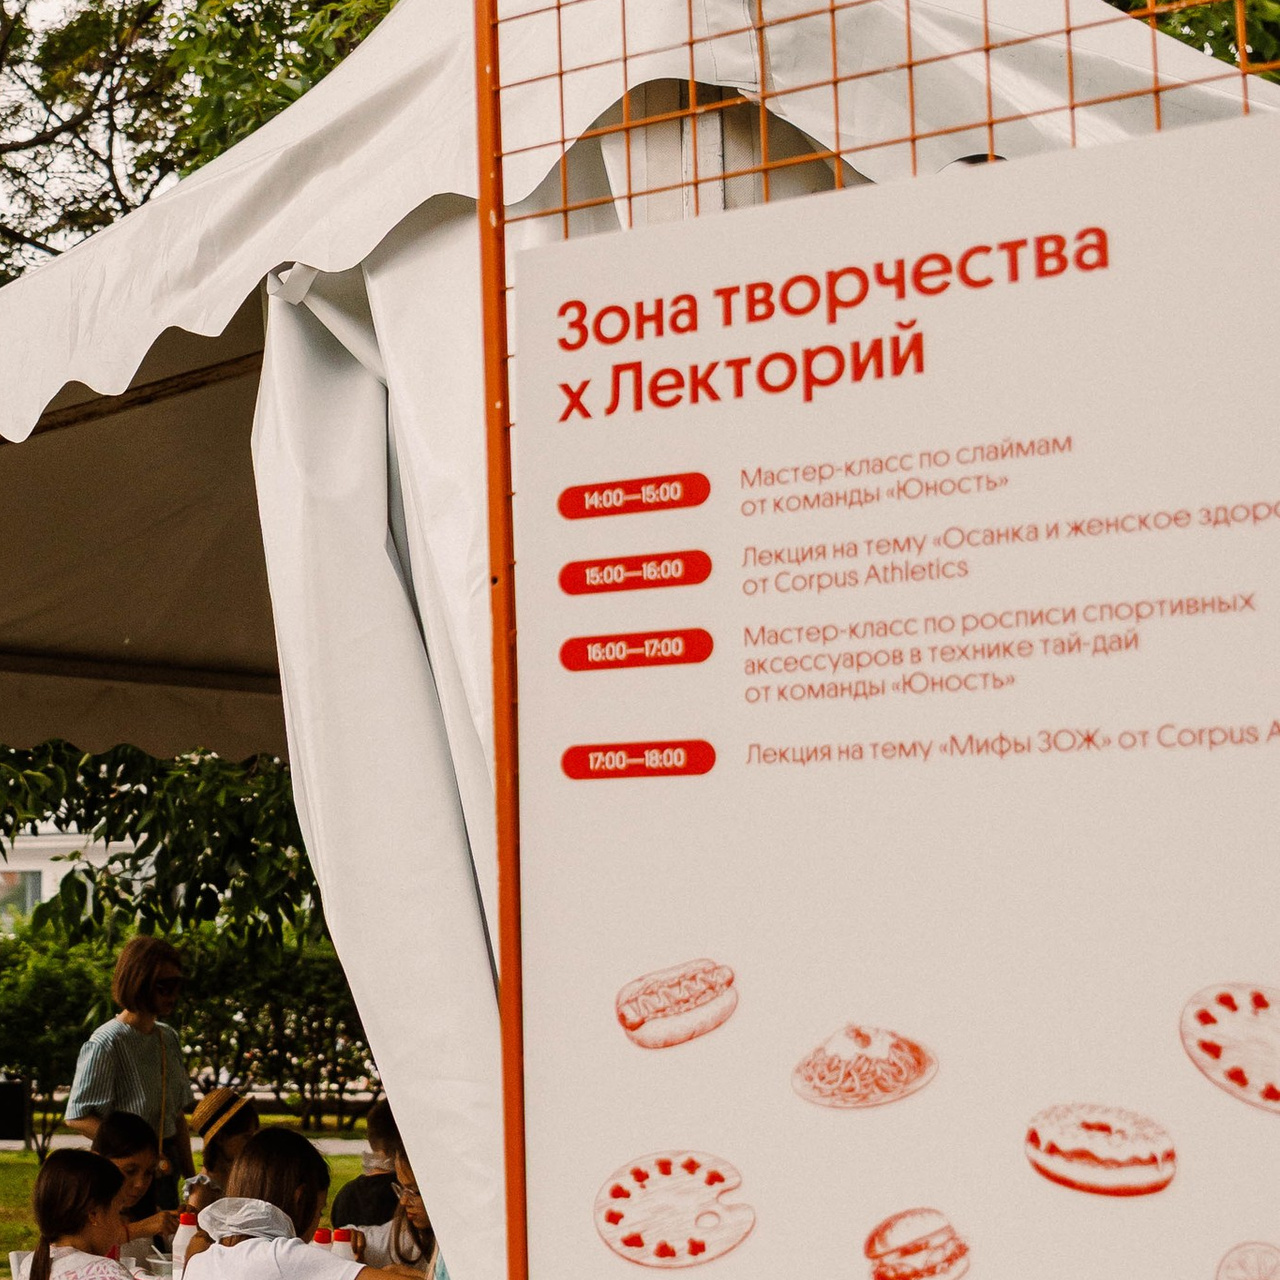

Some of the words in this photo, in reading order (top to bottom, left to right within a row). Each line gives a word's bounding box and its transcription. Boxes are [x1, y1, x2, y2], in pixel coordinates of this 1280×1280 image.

[556, 292, 699, 351] Зона
[714, 226, 1110, 325] творчества
[605, 320, 925, 416] Лекторий
[740, 453, 913, 489] Мастер-класс
[919, 450, 950, 469] по
[956, 435, 1072, 465] слаймам
[741, 498, 766, 516] от
[773, 487, 881, 513] команды
[886, 474, 1008, 501] «Юность»
[742, 544, 826, 567] Лекция
[832, 541, 858, 559] на
[864, 534, 926, 556] тему
[932, 524, 1039, 550] «Осанка
[1046, 522, 1059, 539] и
[1066, 509, 1192, 538] женское
[742, 577, 768, 595] от
[775, 569, 858, 594] Corpus
[864, 557, 969, 585] Athletics
[744, 617, 918, 647] Мастер-класс
[924, 615, 955, 634] по
[961, 606, 1076, 635] росписи
[1082, 592, 1256, 623] спортивных
[744, 647, 903, 675] аксессуаров
[910, 647, 922, 664] в
[928, 639, 1034, 663] технике
[1040, 627, 1139, 656] тай-дай
[744, 685, 770, 704] от
[777, 679, 886, 701] команды
[891, 670, 1015, 694] «Юность»
[746, 743, 831, 766] Лекция
[837, 742, 863, 760] на
[870, 739, 933, 761] тему
[939, 732, 1031, 760] «Мифы
[1037, 726, 1111, 753] ЗОЖ»
[1118, 729, 1149, 749] от
[1157, 723, 1259, 751] Corpus
